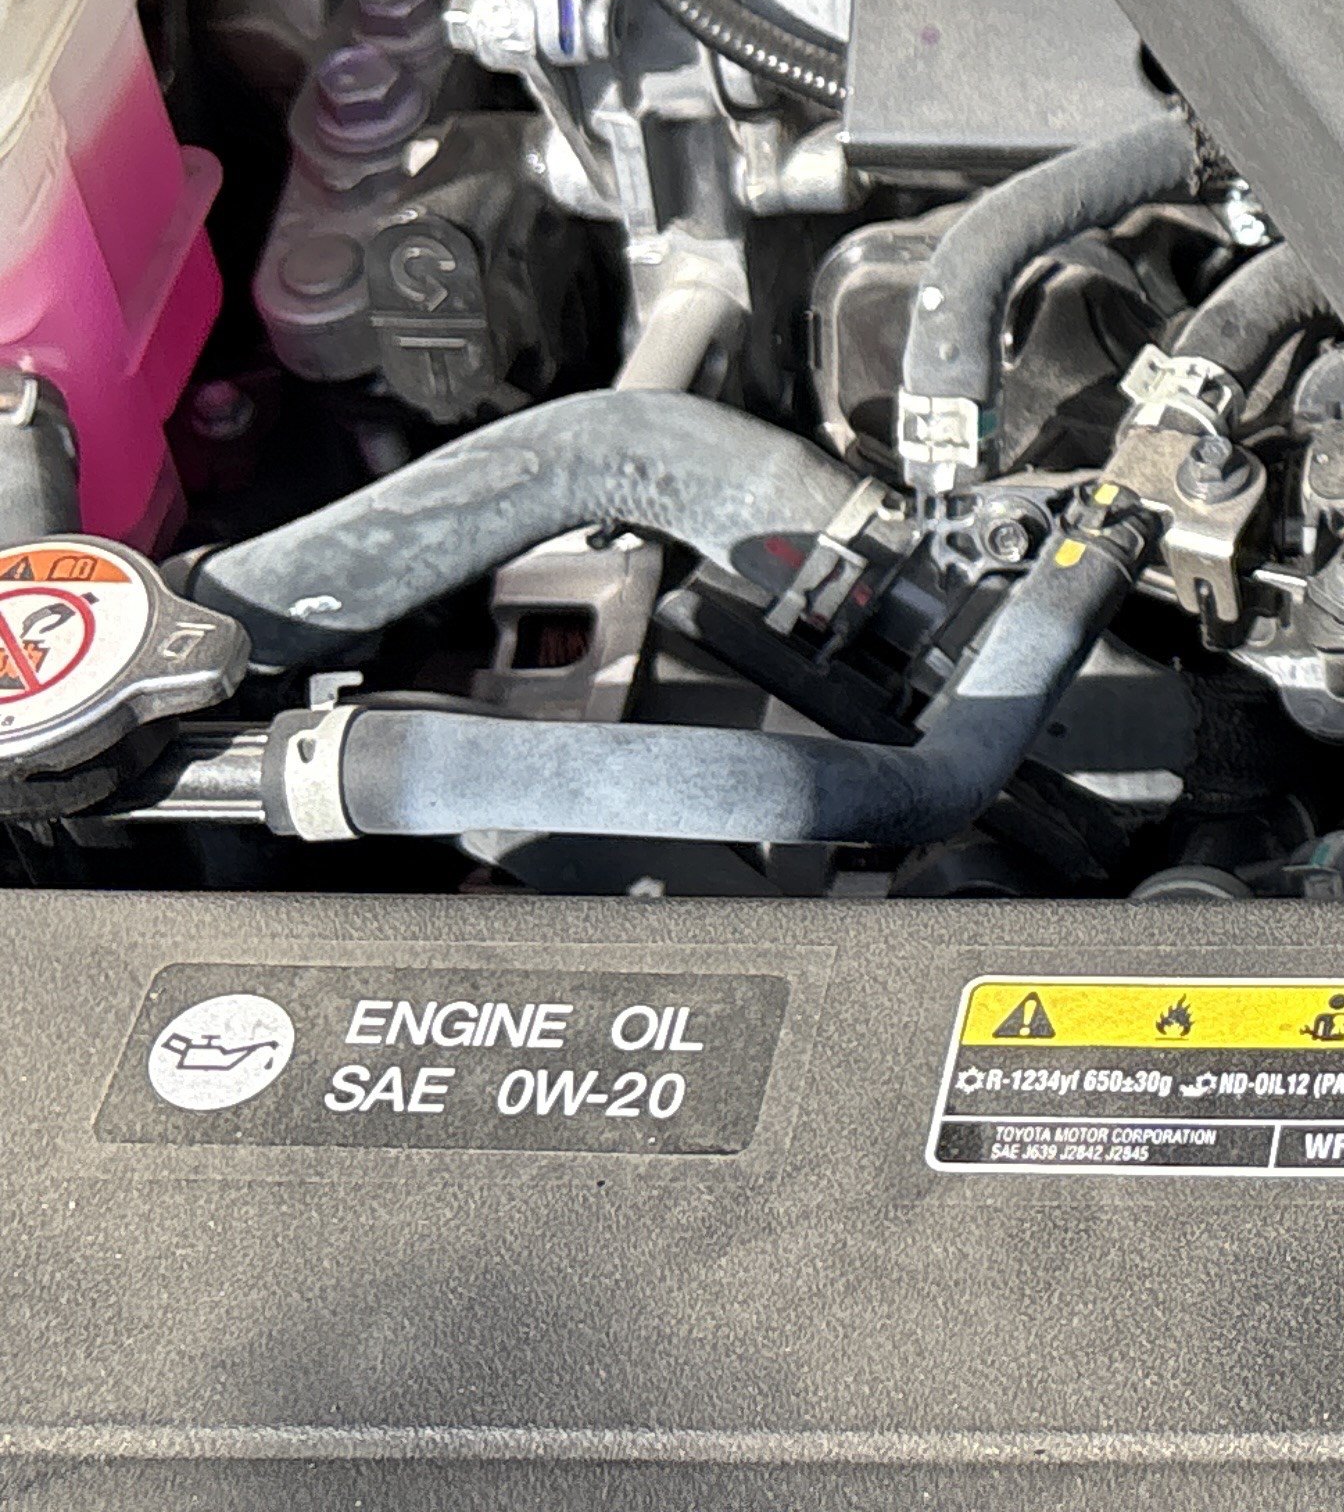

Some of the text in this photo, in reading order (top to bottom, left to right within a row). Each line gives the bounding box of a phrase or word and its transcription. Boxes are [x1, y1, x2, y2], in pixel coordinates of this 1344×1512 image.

[344, 999, 704, 1052] ENGINE OIL
[323, 1064, 686, 1120] SAE 0W-20
[985, 1068, 1081, 1095] R-1234yf
[1083, 1069, 1173, 1097] 650±30g
[995, 1125, 1217, 1145] TOYOTA MOTOR CORPORATION
[991, 1143, 1020, 1161] SAE
[1059, 1144, 1103, 1162] J2842
